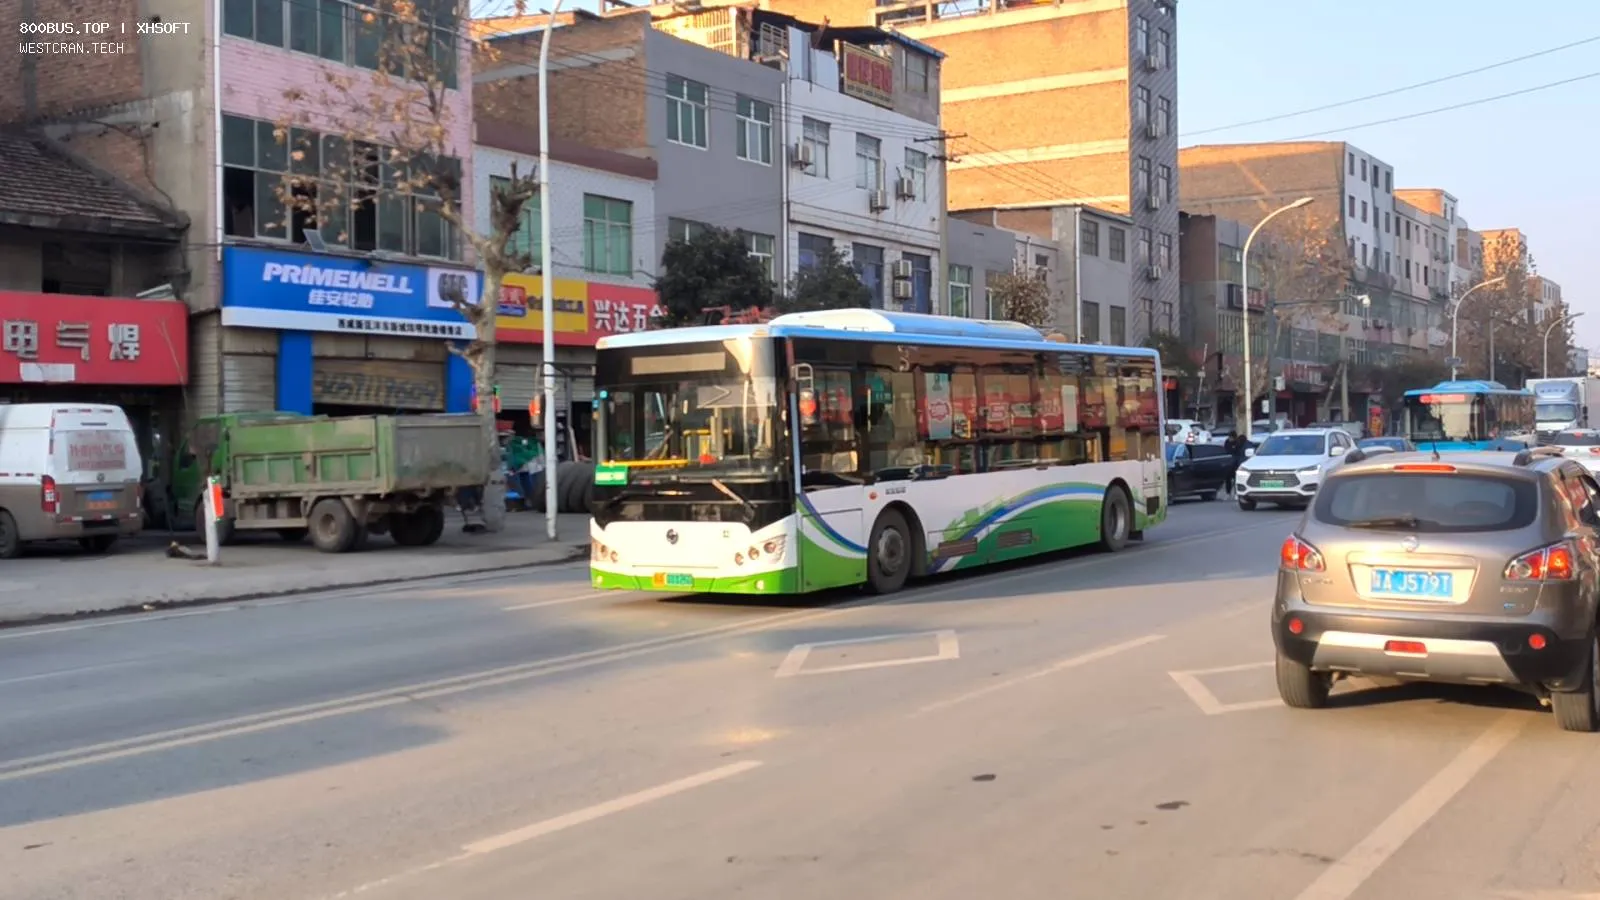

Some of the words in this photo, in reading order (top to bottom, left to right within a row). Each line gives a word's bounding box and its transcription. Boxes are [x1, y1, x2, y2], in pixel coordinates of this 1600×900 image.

[263, 262, 413, 294] PRIMEWELL
[308, 289, 374, 308] 佳安轮胎
[3, 320, 139, 361] 电气焊
